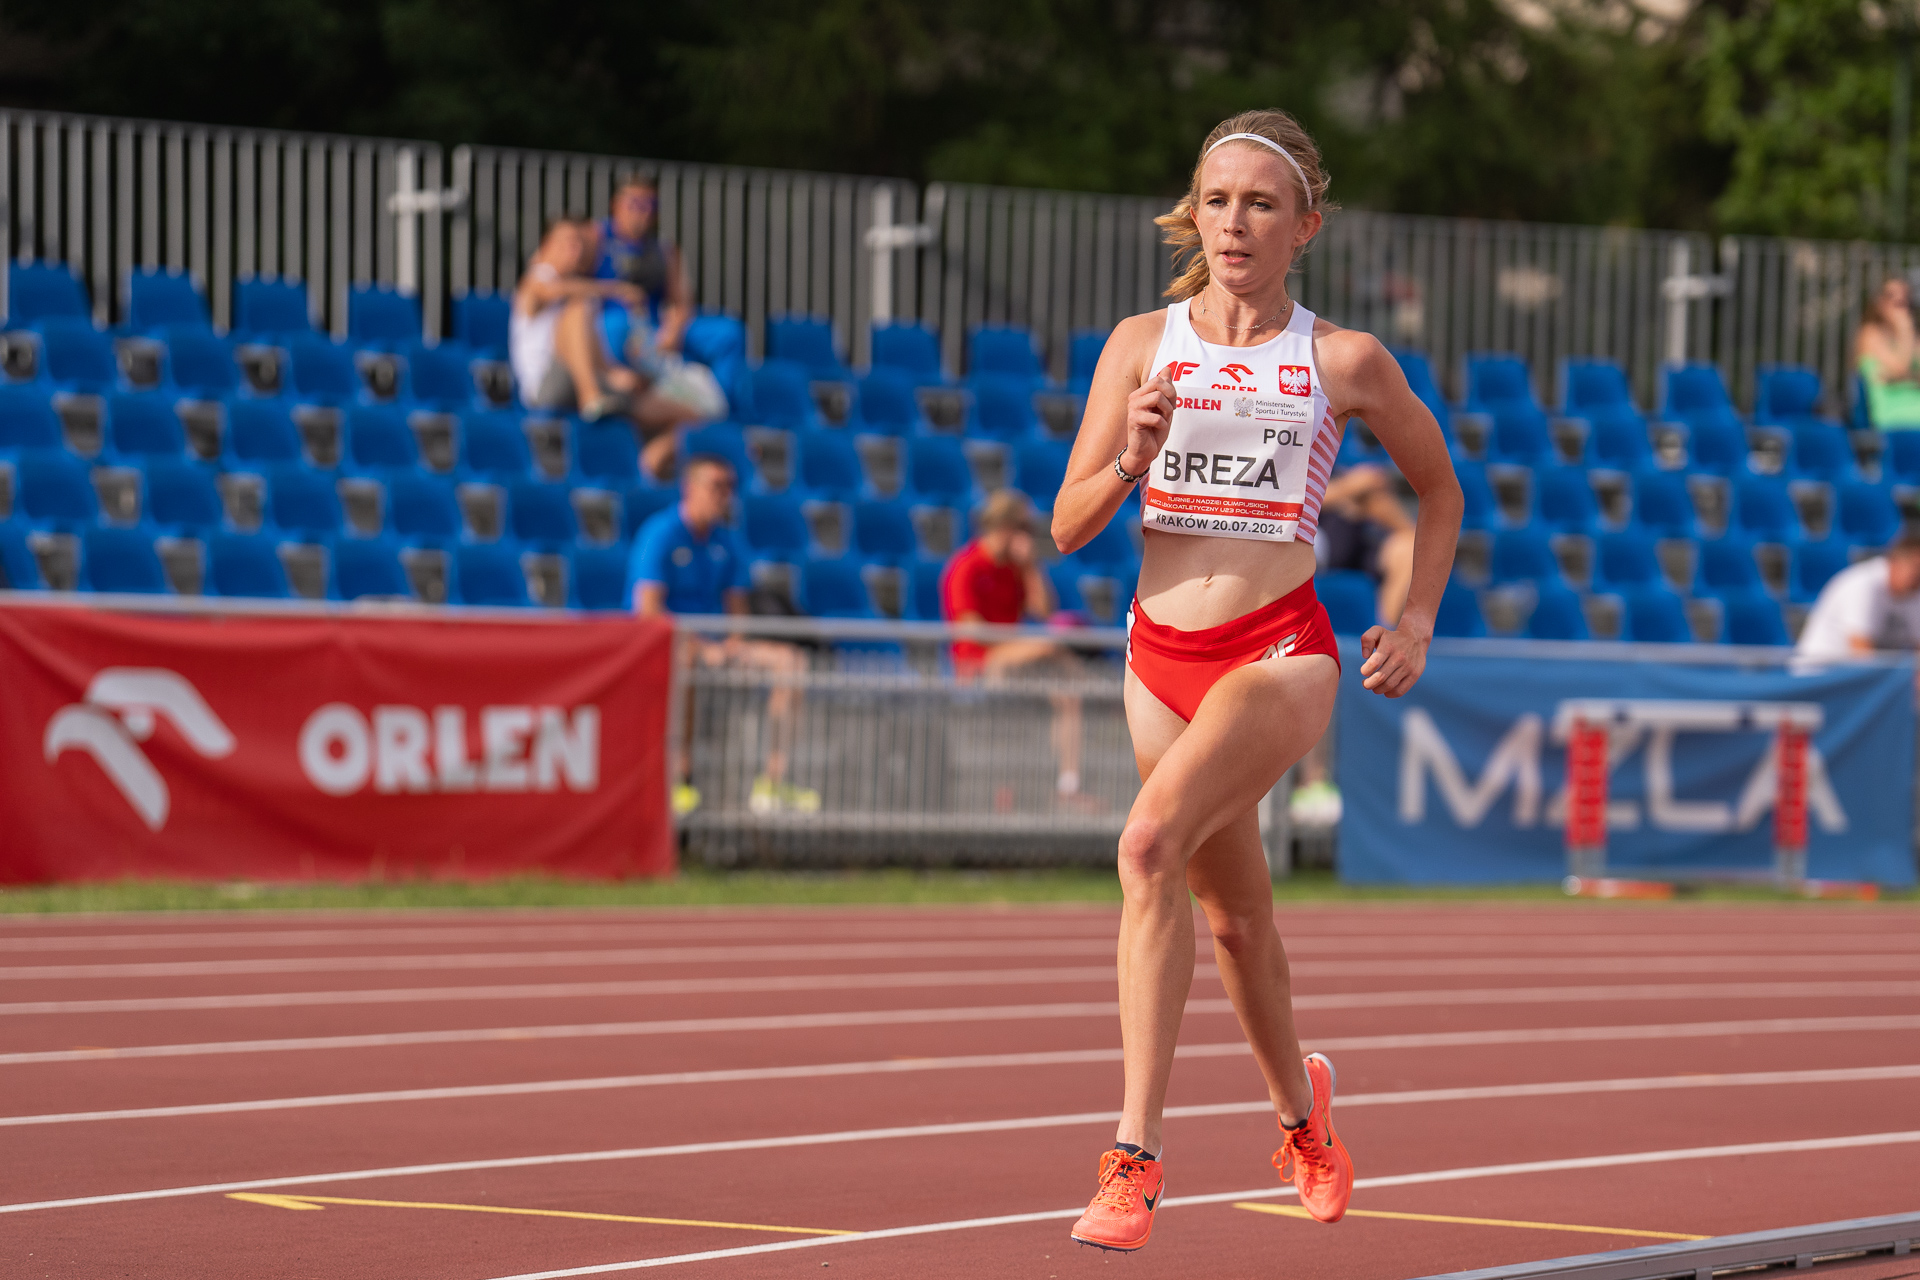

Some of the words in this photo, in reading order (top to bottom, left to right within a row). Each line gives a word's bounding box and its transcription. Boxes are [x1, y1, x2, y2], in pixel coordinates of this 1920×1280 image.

[1255, 400, 1295, 409] Ministerstwo
[1255, 407, 1276, 415] Sportu
[1280, 409, 1308, 418] Turystyki
[1263, 428, 1304, 447] POL
[1163, 449, 1280, 490] BREZA
[1150, 498, 1162, 506] MECZ
[1161, 502, 1219, 512] LEKKOATLETYCZNY
[1235, 508, 1298, 518] POL-CZE-HUN-UKR
[1167, 496, 1195, 504] TURNIEJ
[1222, 500, 1269, 509] OLIMPIJSKICH
[1155, 513, 1209, 529] KRAKÓW
[1212, 519, 1284, 534] 20.07.2024
[301, 703, 599, 795] ORLEN
